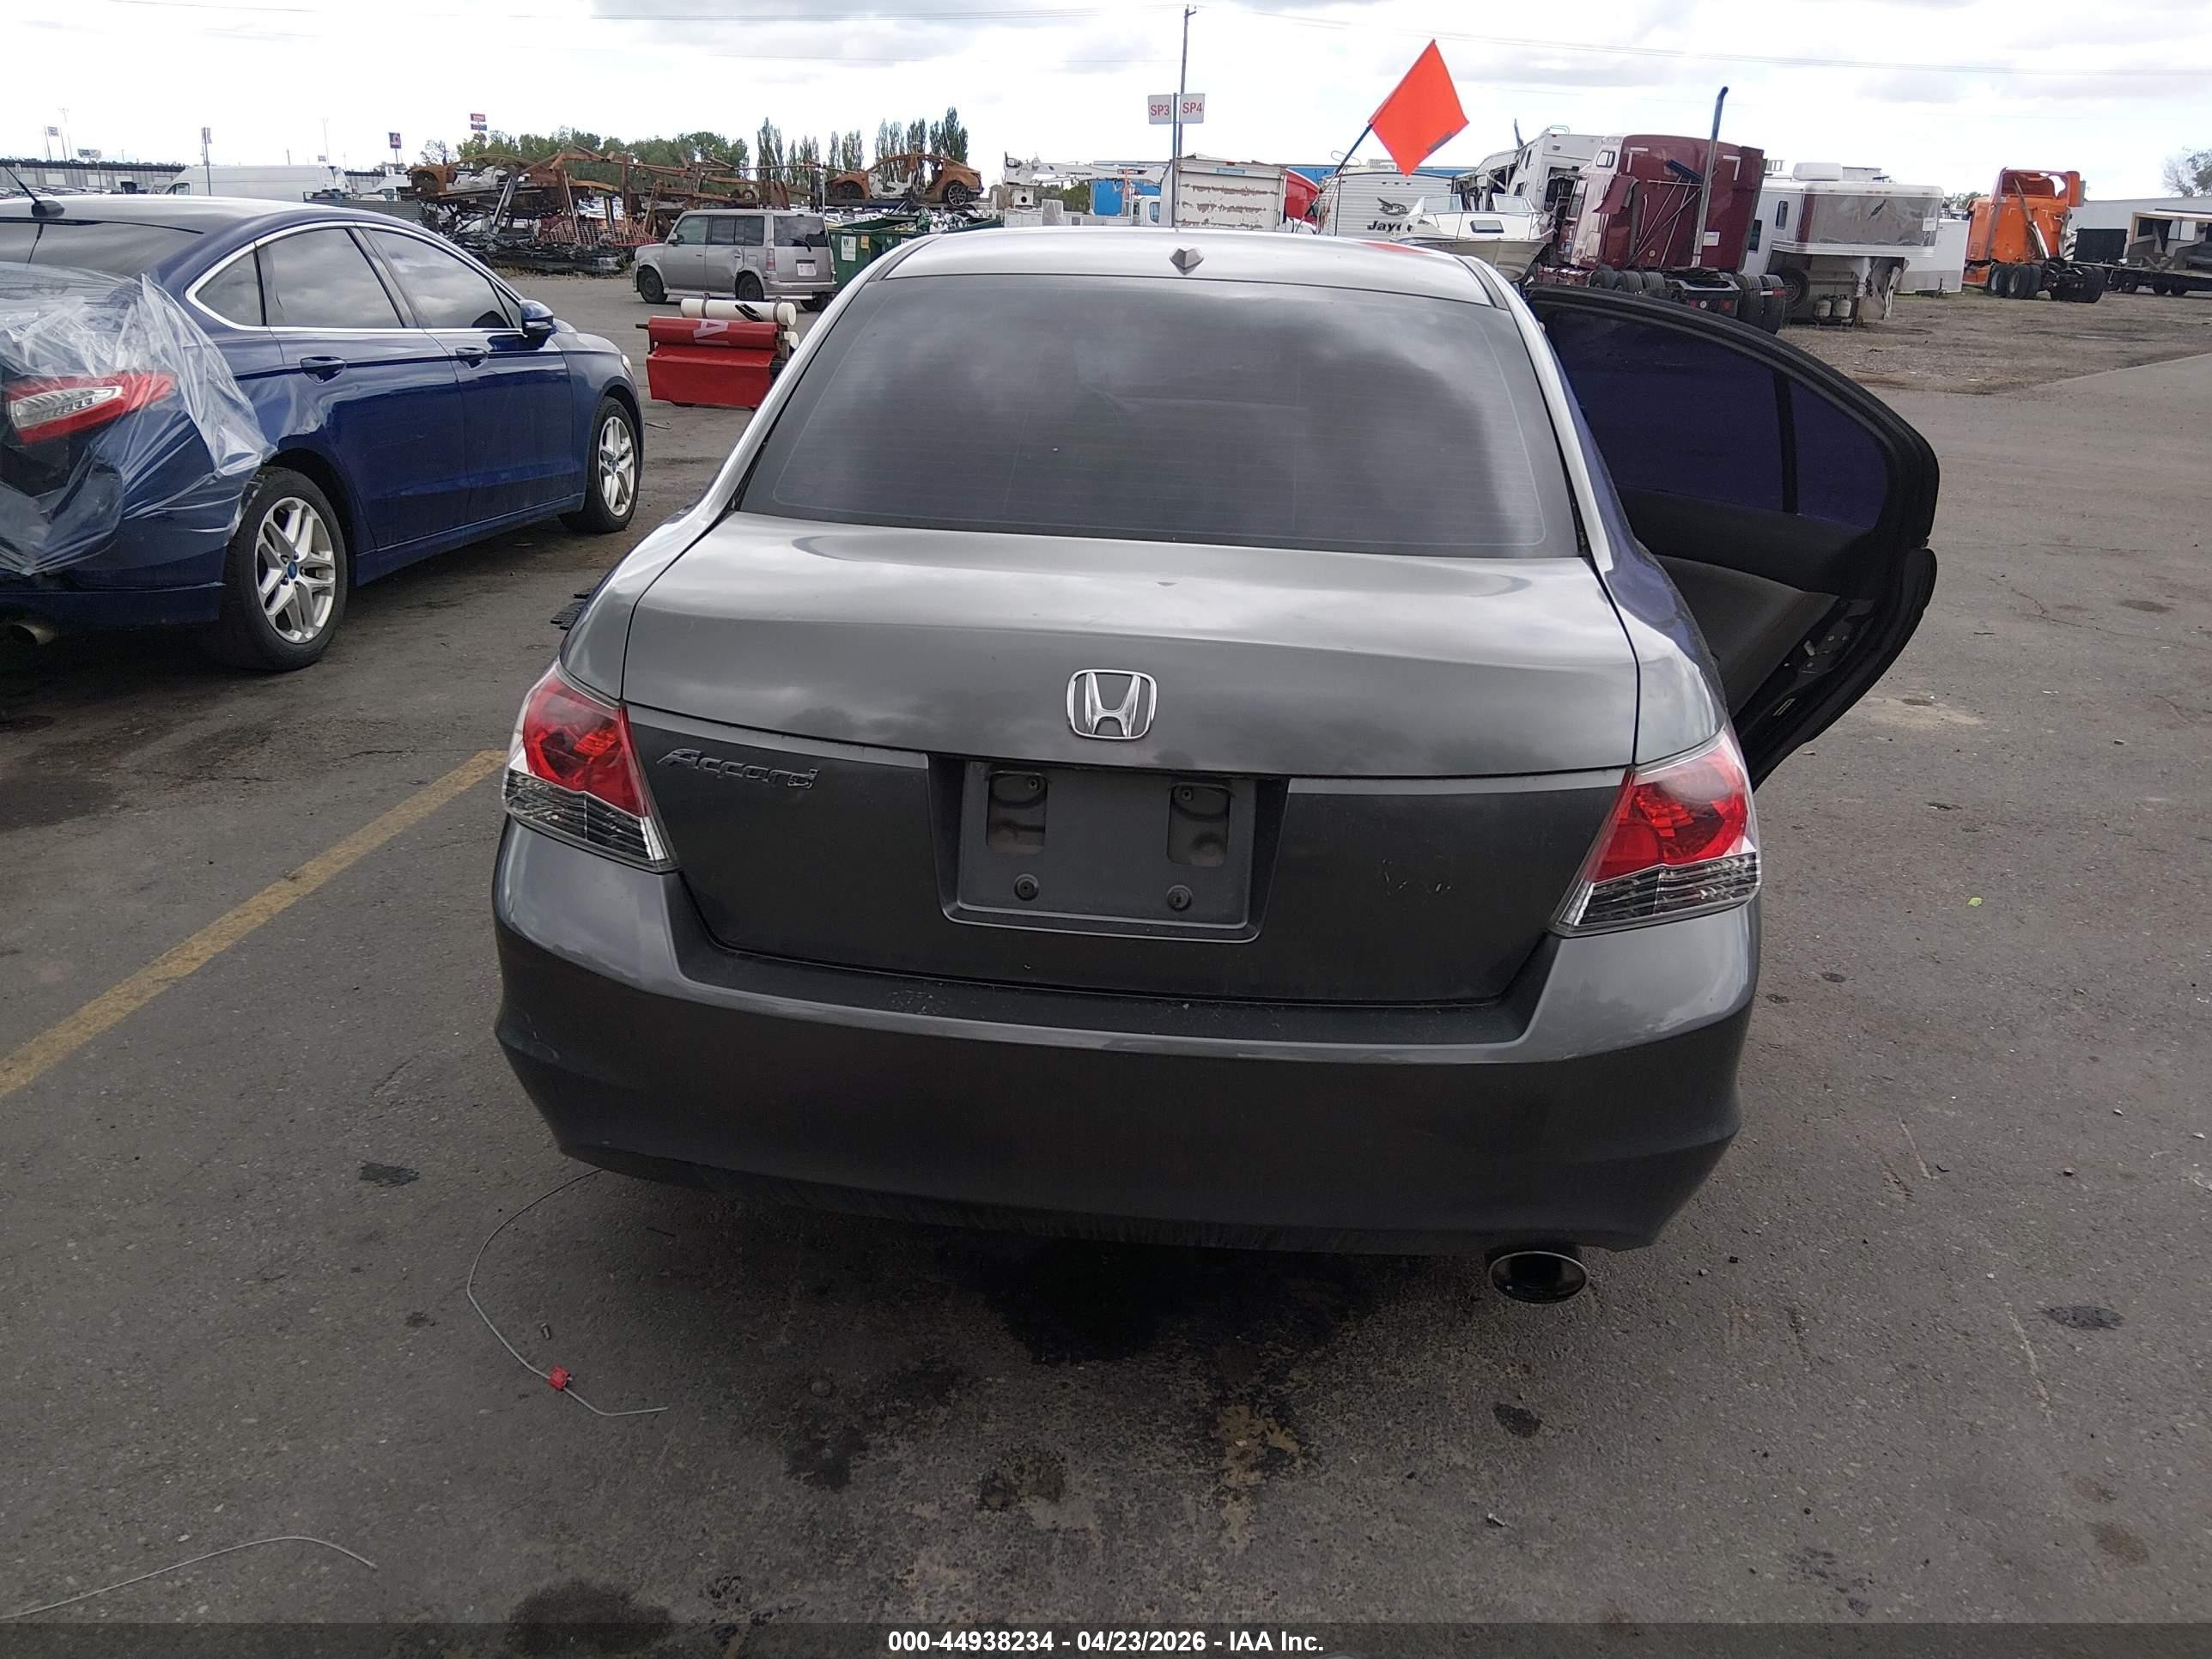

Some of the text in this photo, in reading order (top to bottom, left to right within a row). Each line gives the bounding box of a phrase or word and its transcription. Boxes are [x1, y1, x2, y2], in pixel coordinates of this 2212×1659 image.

[1151, 104, 1170, 116] SP3
[1182, 102, 1202, 113] SP4
[656, 748, 818, 789] Accord
